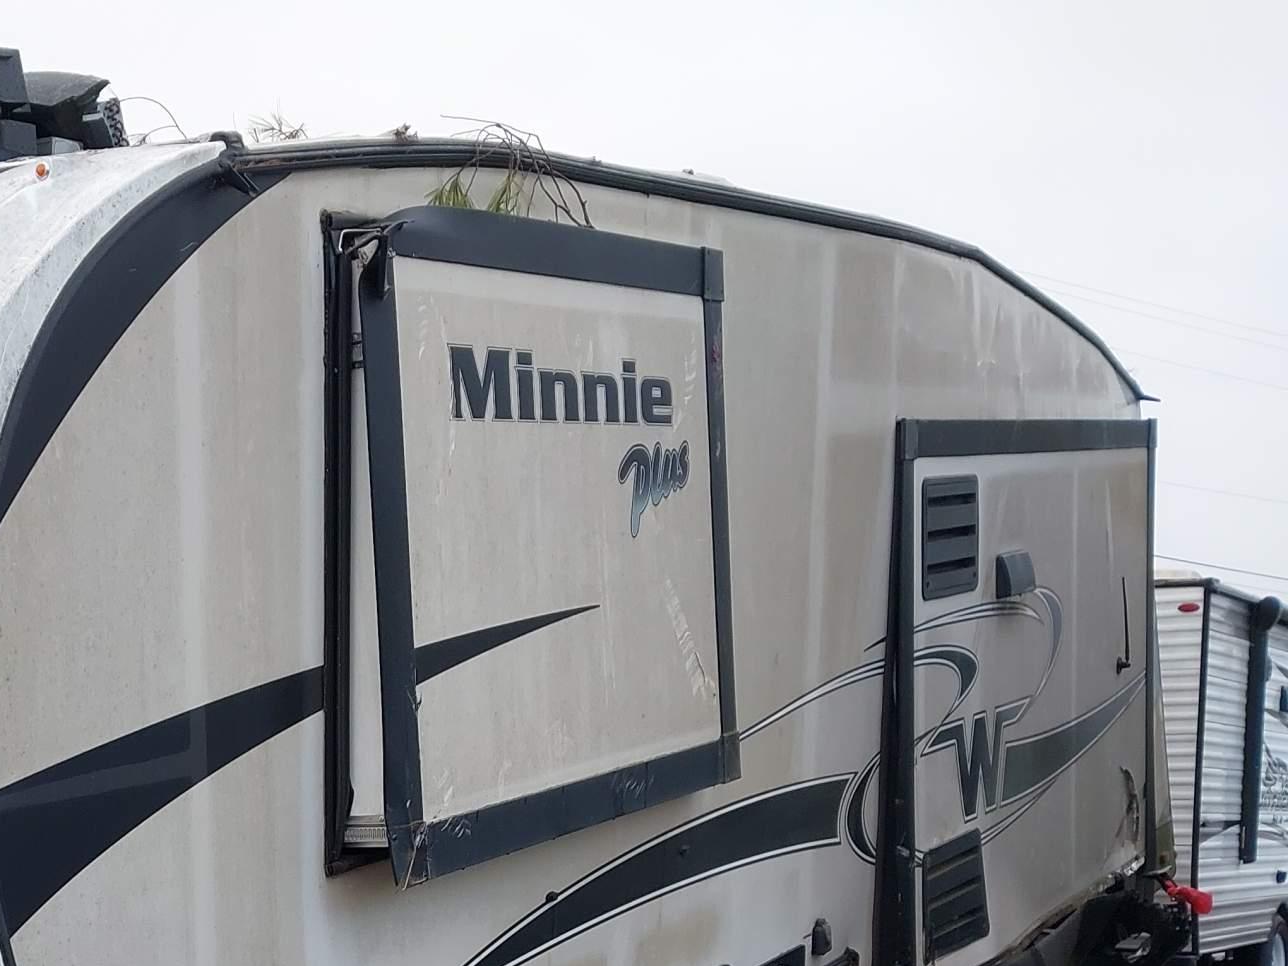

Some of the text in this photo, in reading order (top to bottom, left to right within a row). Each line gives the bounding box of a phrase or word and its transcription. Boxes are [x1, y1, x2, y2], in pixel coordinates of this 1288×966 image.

[447, 343, 673, 427] Minnie
[618, 440, 690, 538] Plus
[920, 695, 1032, 824] W
